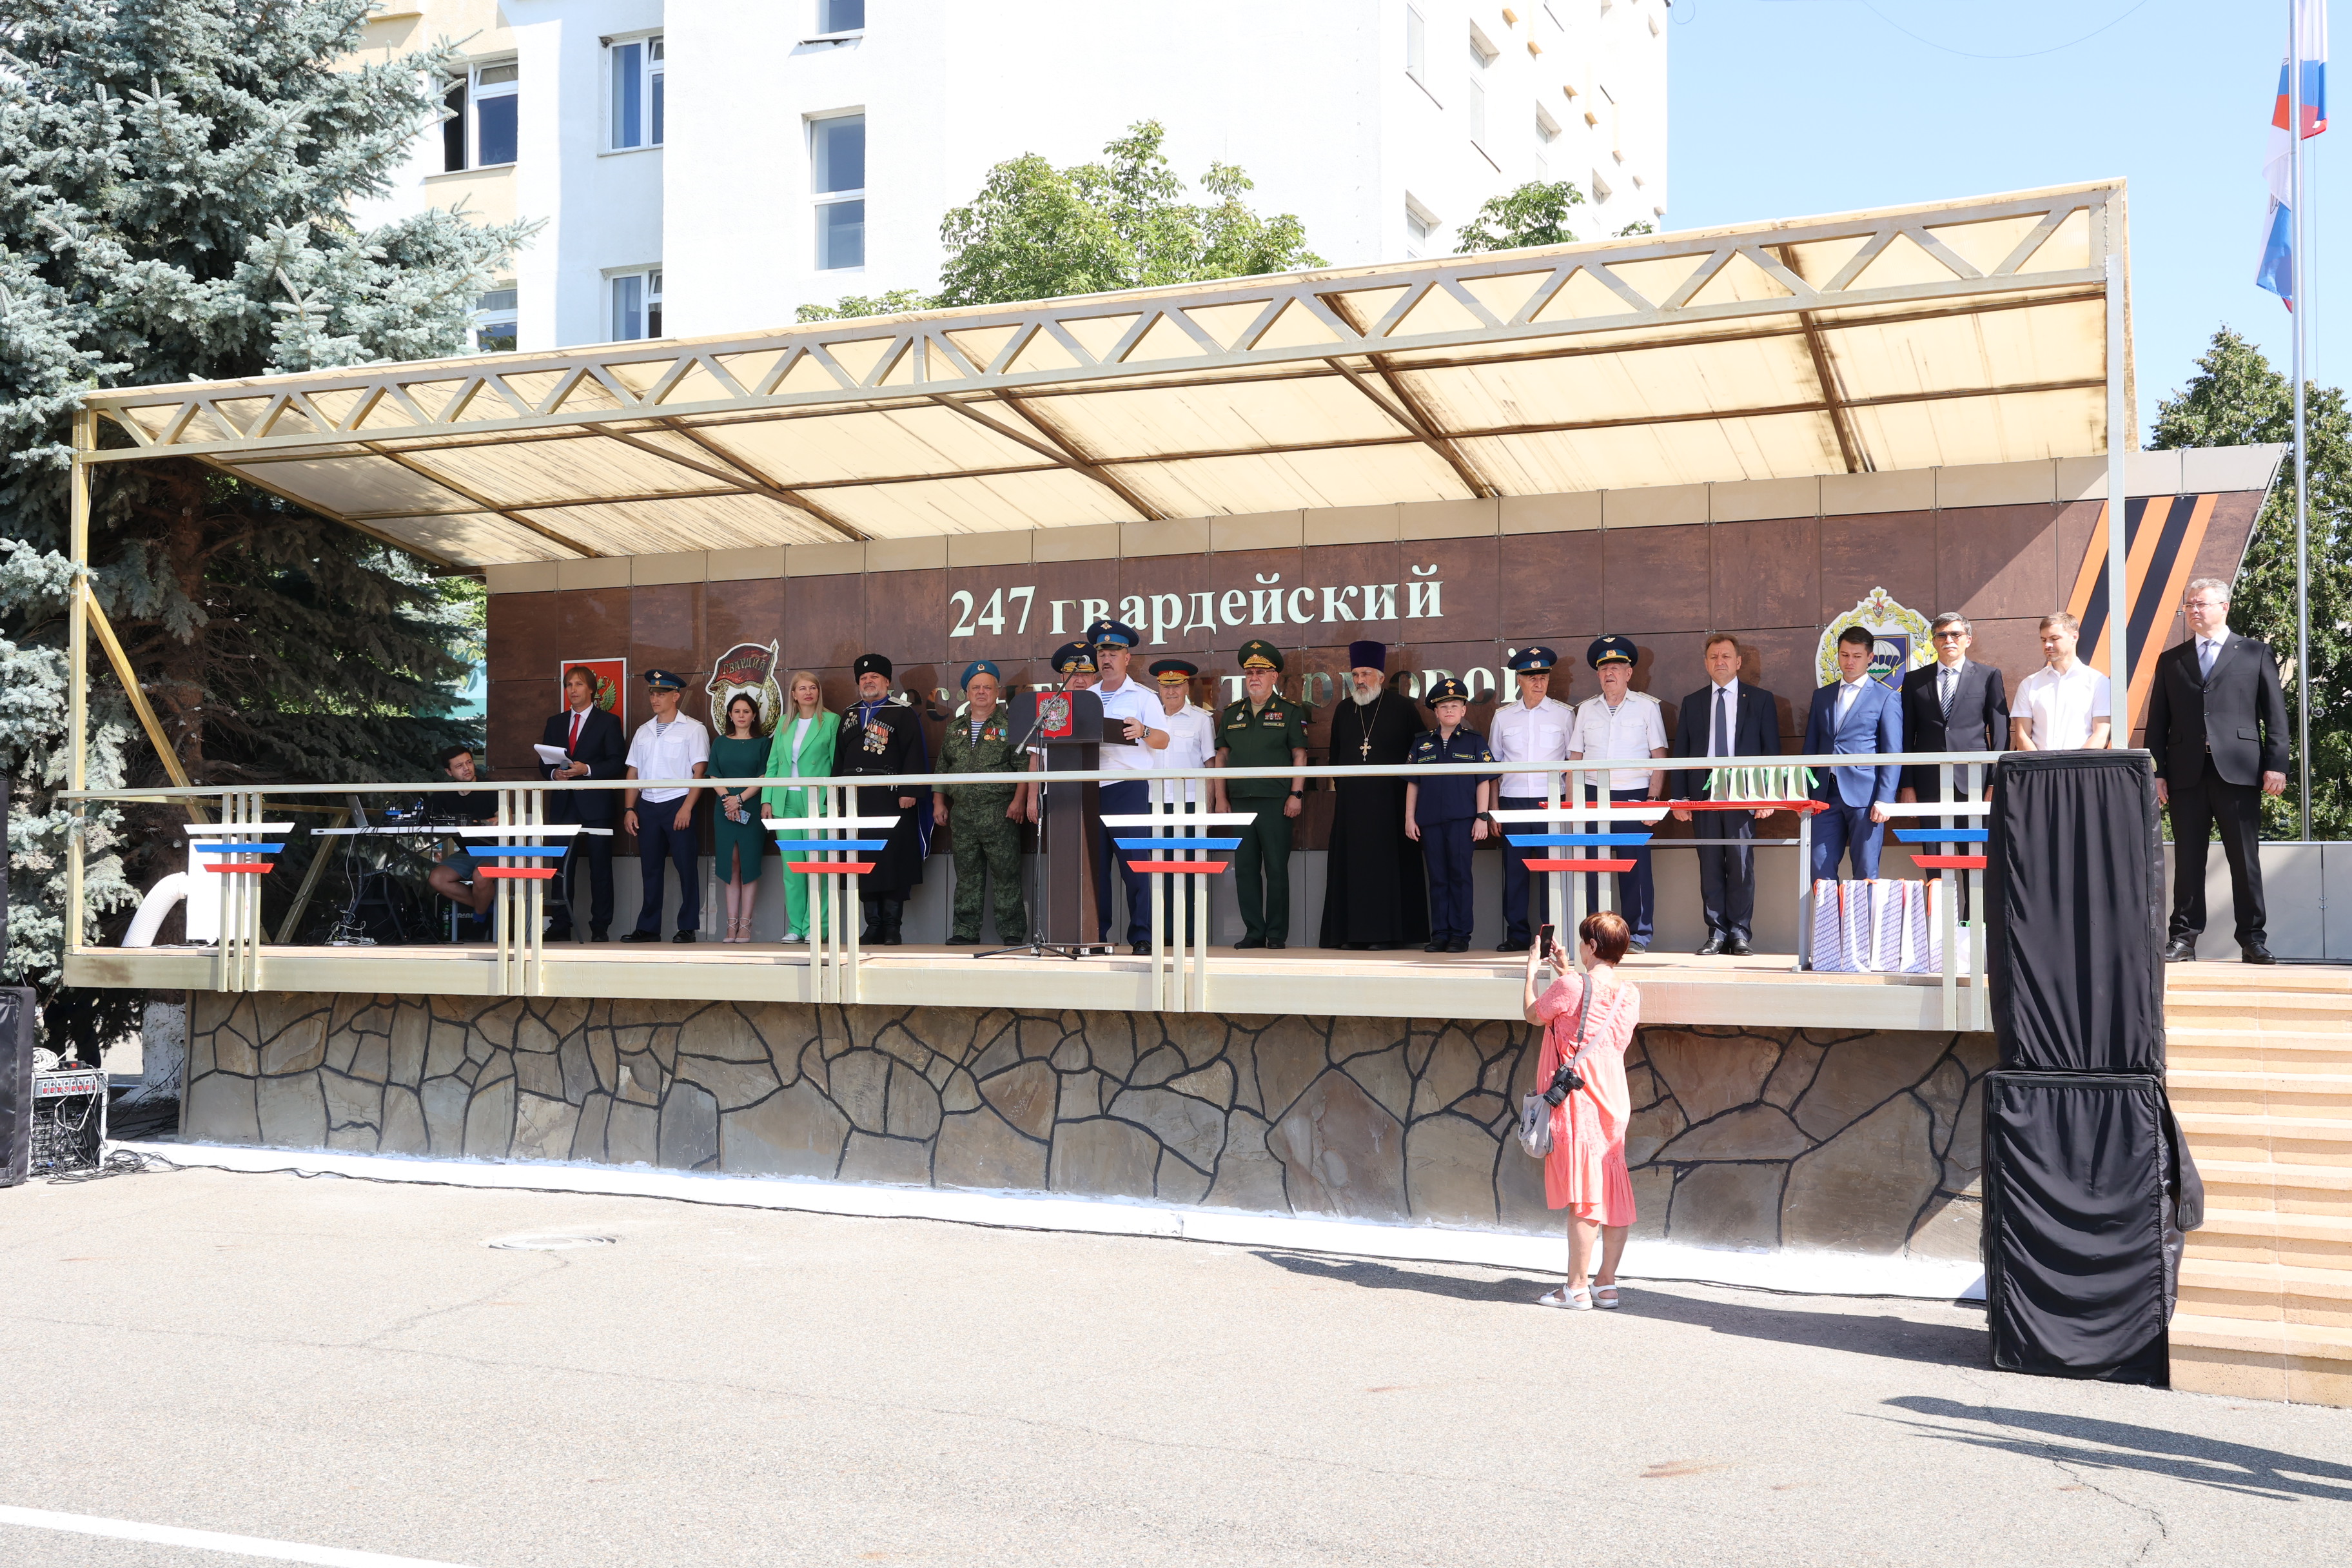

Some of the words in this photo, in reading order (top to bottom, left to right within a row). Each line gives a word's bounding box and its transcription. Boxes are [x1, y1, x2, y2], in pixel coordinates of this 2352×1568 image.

[950, 586, 1035, 638] 247
[1050, 564, 1444, 645] гвардейский
[722, 657, 767, 674] ГВАРДИЯ
